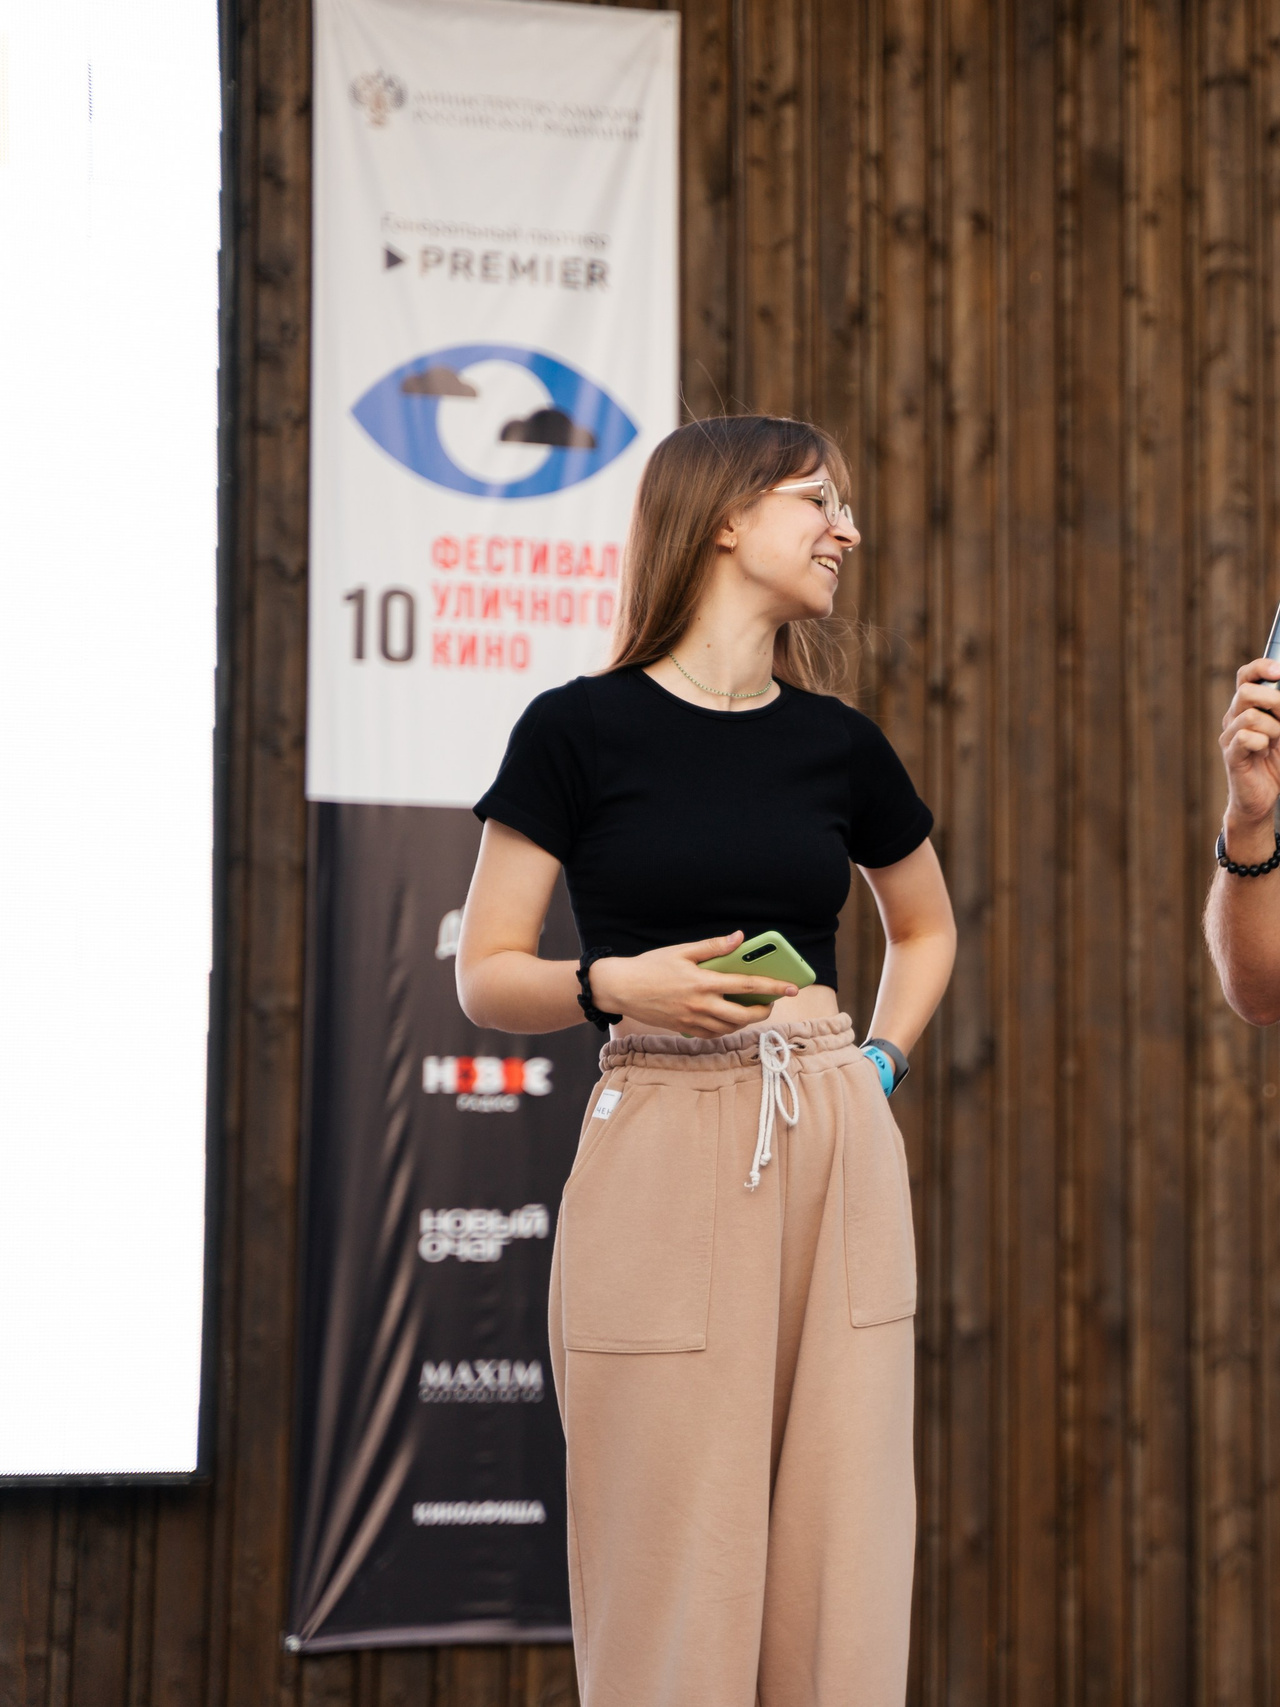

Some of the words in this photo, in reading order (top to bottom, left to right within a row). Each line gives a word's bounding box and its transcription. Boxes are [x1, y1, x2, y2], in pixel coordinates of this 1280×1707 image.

[419, 246, 611, 291] PREMIER
[431, 533, 621, 580] ФЕСТИВАЛ
[344, 586, 417, 664] 10
[431, 581, 616, 628] УЛИЧНОГО
[431, 631, 533, 672] КИНО
[420, 1360, 544, 1391] MAXIM
